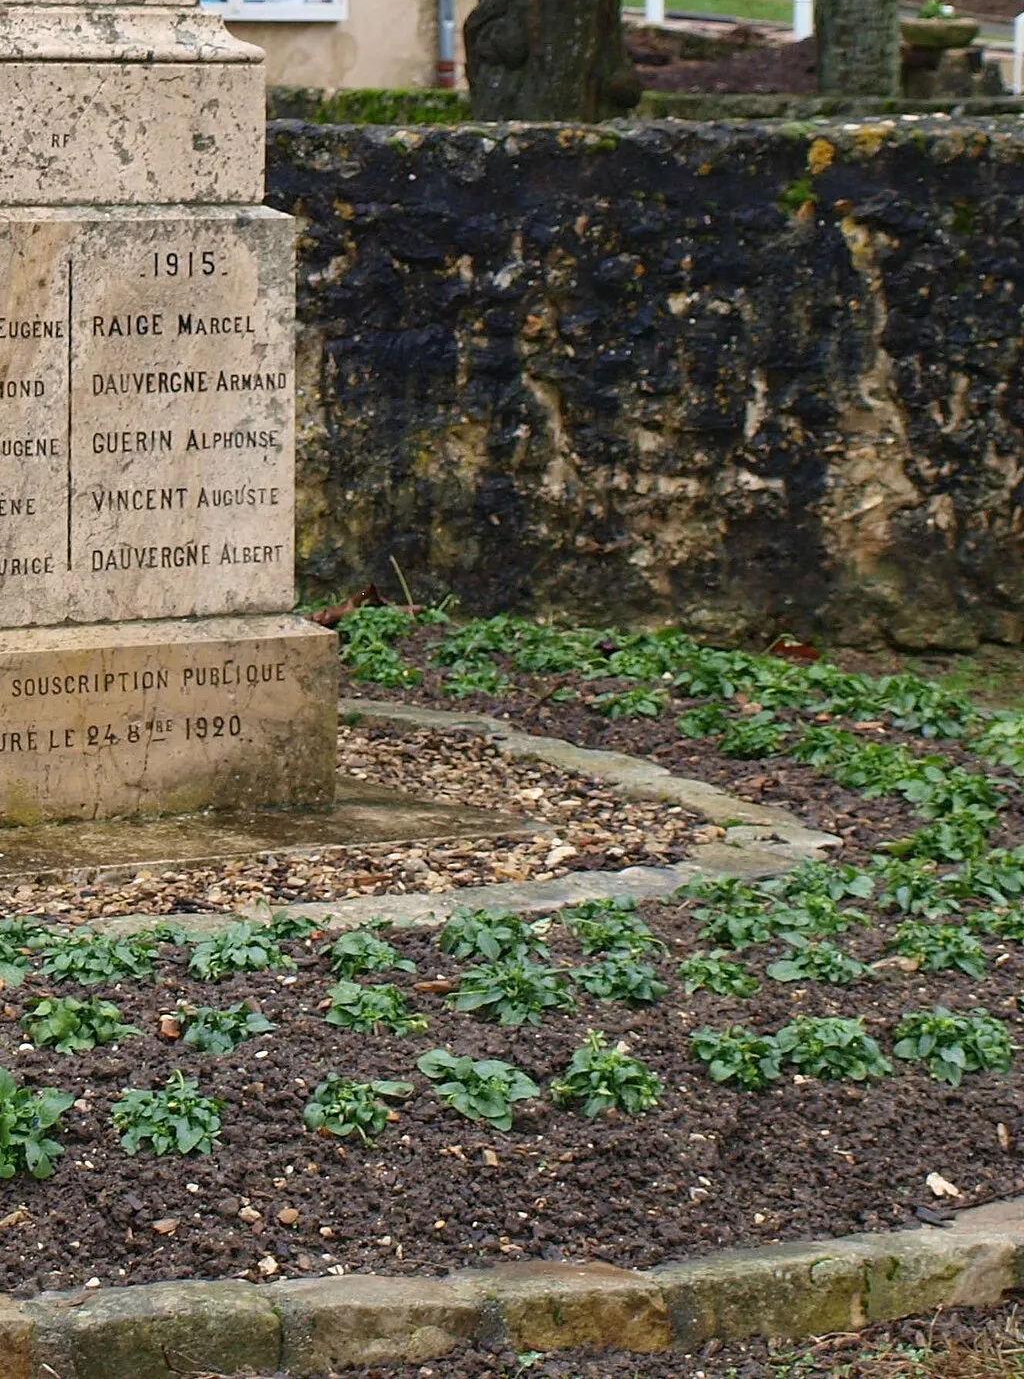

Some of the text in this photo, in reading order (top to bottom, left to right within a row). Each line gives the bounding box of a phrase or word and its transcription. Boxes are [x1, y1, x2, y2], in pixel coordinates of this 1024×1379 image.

[92, 313, 256, 337] RAIGE MARCEL
[92, 371, 287, 396] DAUVERGNE ARMAND
[185, 428, 280, 452] ALPHONSE
[92, 486, 279, 512] VINCENT AUGUSTE
[92, 544, 284, 572] DAUVERGNE ALBERT
[12, 670, 169, 698] SOUSCRIPTION
[183, 660, 286, 688] PUBLIQUE
[49, 729, 75, 751] LE
[87, 724, 119, 746] 24
[186, 715, 241, 740] 1920
